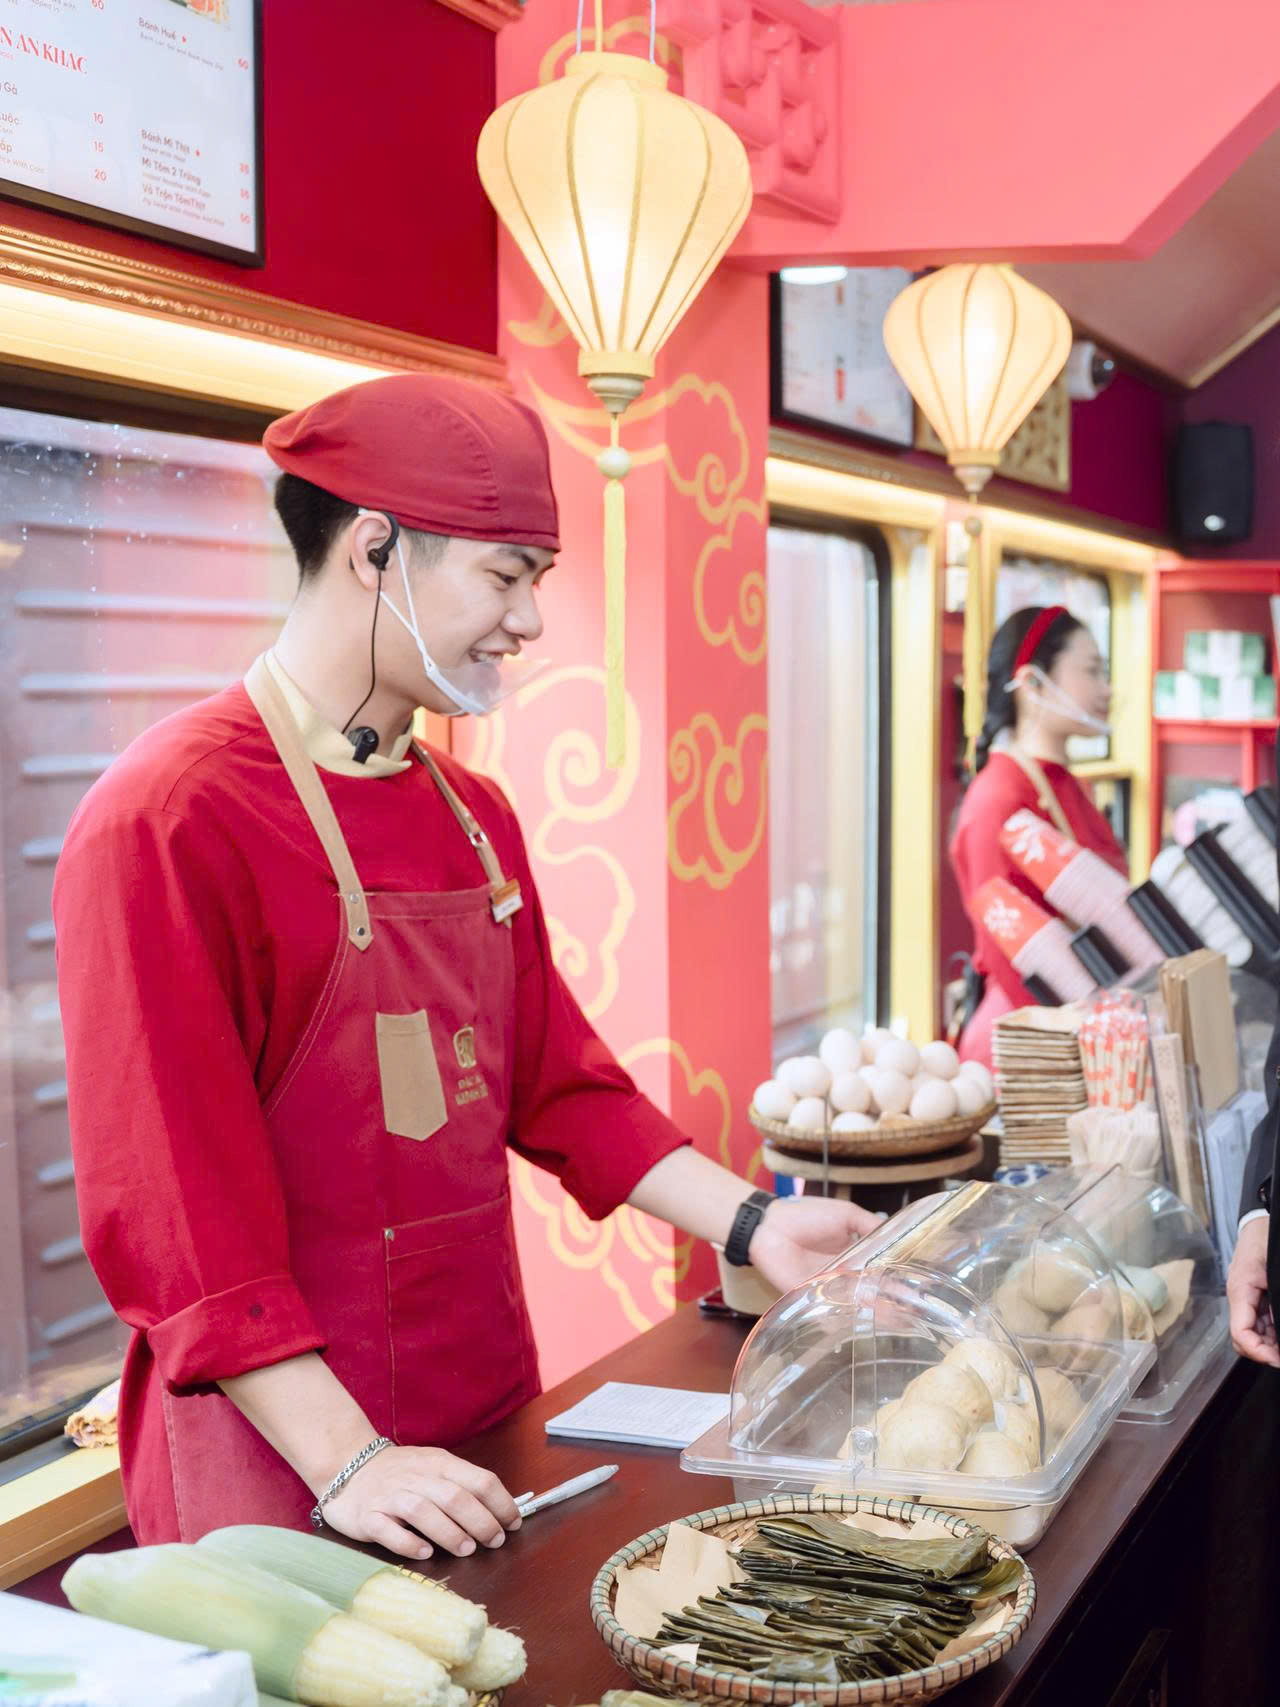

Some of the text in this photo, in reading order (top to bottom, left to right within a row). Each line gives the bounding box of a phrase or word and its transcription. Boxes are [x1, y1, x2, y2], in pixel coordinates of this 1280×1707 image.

[0, 112, 20, 126] uộc
[93, 112, 104, 125] 10
[93, 140, 104, 153] 15
[94, 168, 107, 182] 20
